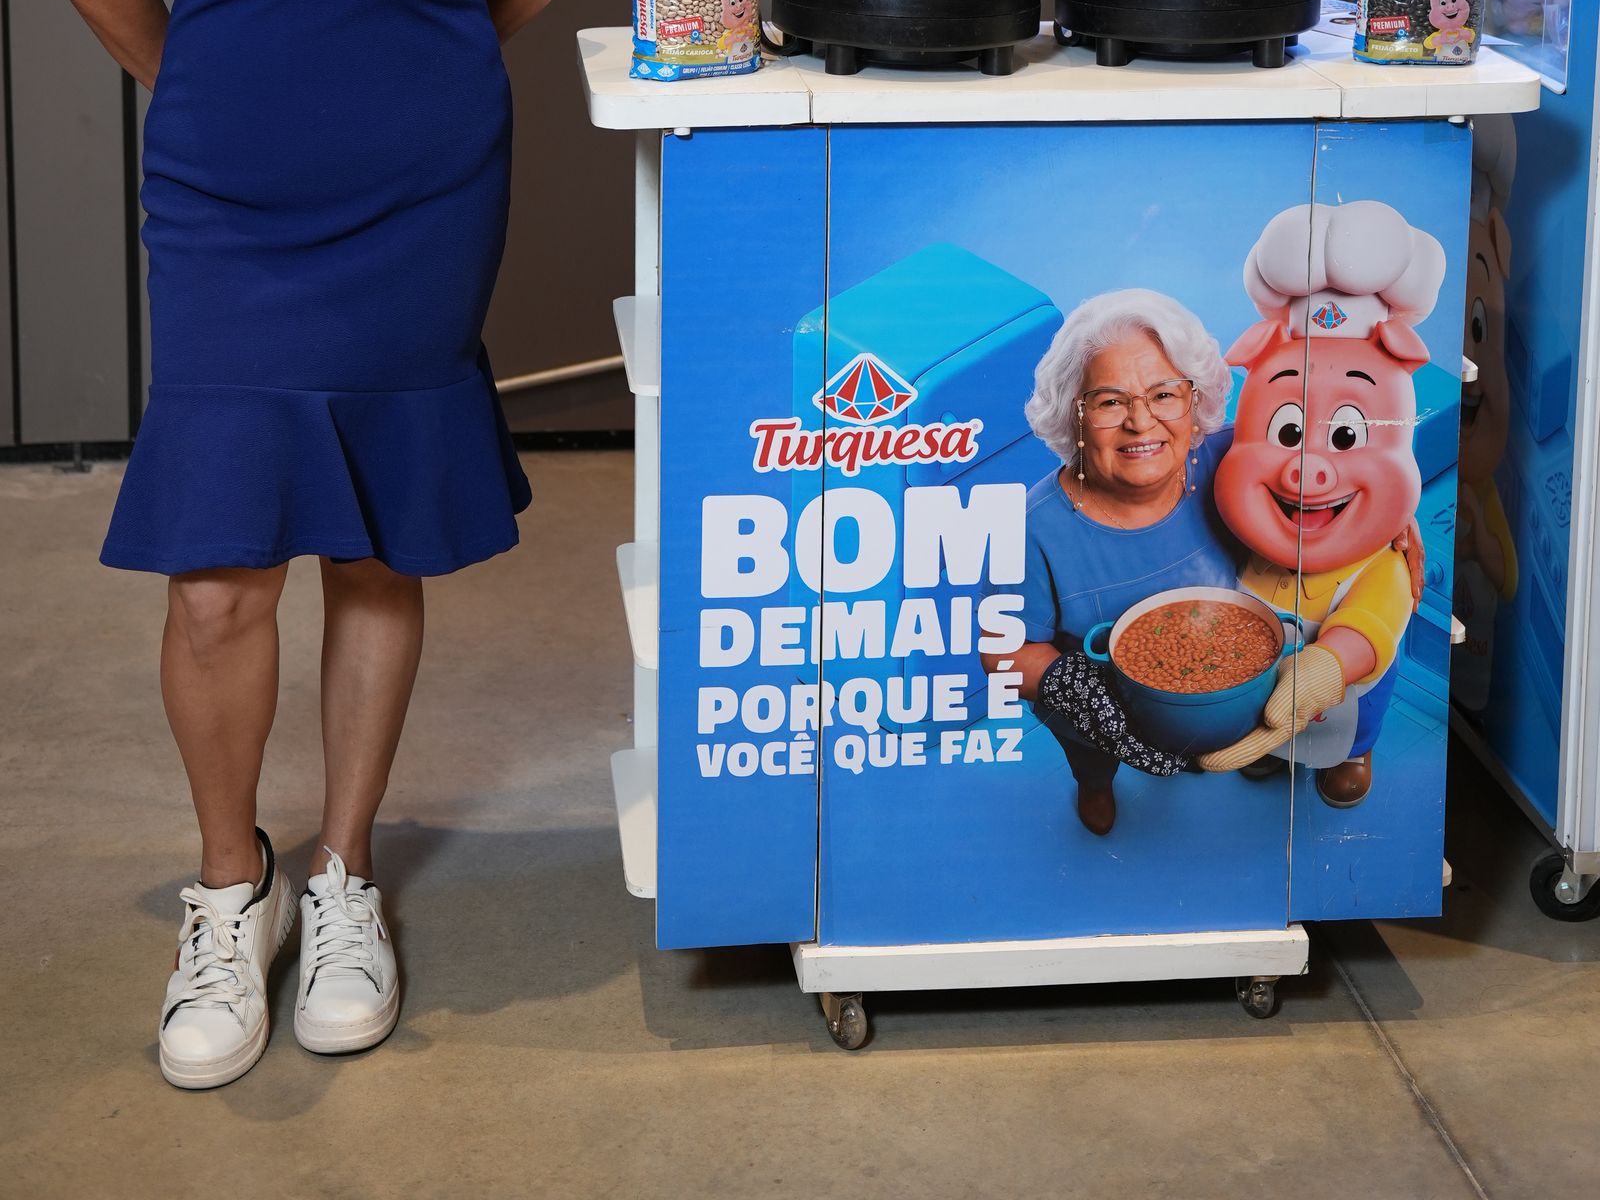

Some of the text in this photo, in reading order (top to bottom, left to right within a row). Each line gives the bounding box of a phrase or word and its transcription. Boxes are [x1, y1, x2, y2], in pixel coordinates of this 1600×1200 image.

[665, 21, 699, 34] PREMIUM
[1373, 20, 1405, 30] PREMIUM
[754, 422, 976, 472] Turquesa
[701, 483, 1027, 598] BOM
[699, 594, 1027, 668] DEMAIS
[697, 659, 1023, 735] PORQUE É
[696, 728, 1023, 778] VOCÊ QUE FAZ
